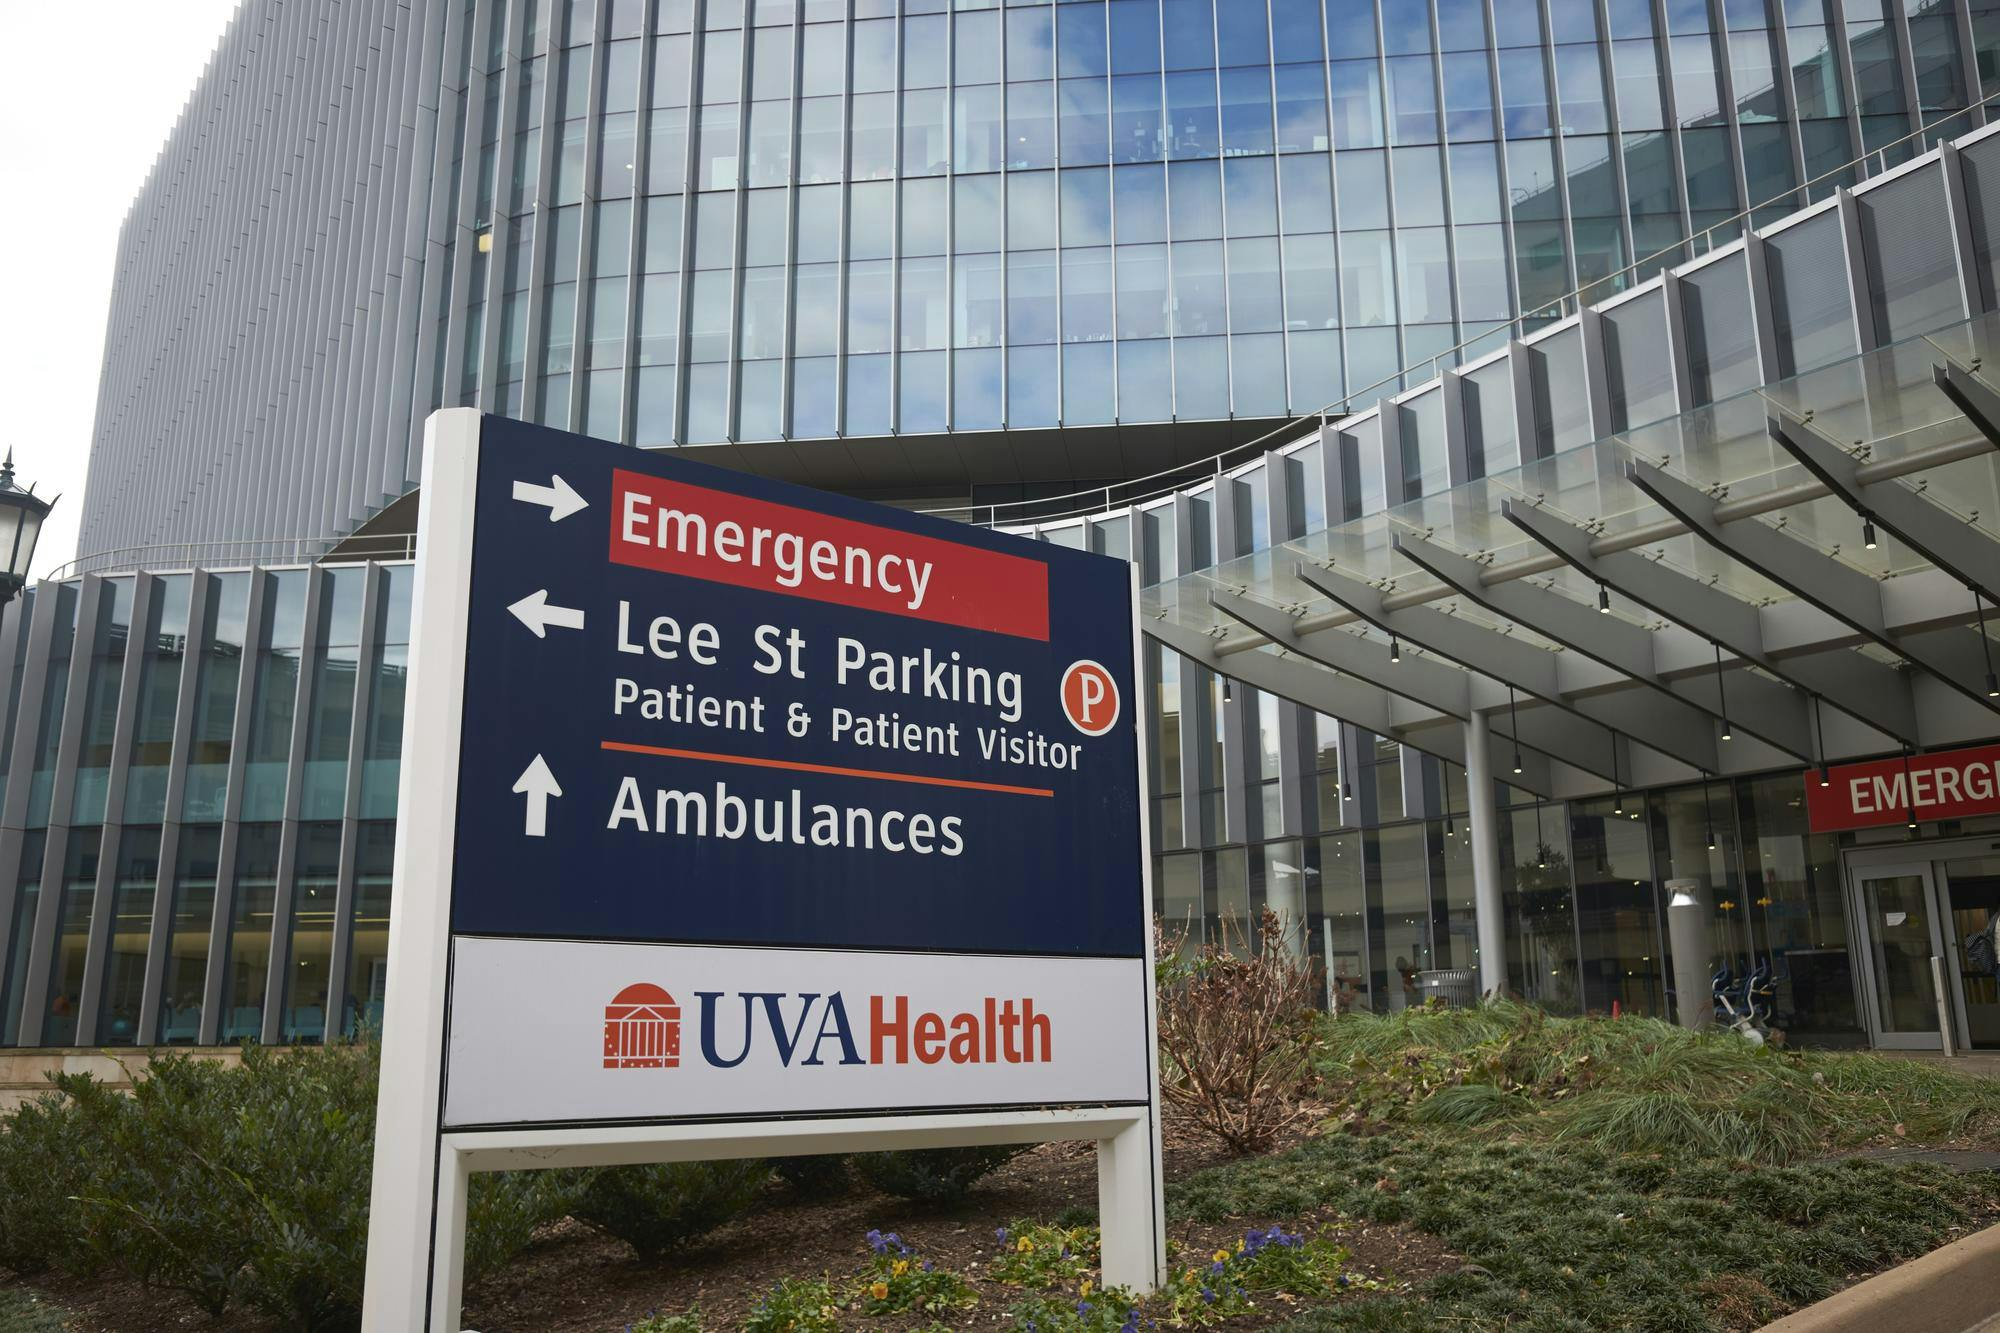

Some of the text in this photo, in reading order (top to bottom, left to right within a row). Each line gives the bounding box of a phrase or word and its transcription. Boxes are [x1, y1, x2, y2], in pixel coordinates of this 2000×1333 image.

[622, 492, 933, 609] Emergency
[616, 601, 1023, 723] Lee St Parking
[1078, 672, 1105, 723] P
[614, 679, 1082, 771] Patient & Patient Visitor
[606, 776, 965, 857] Ambulances
[1850, 760, 2000, 814] EMERG
